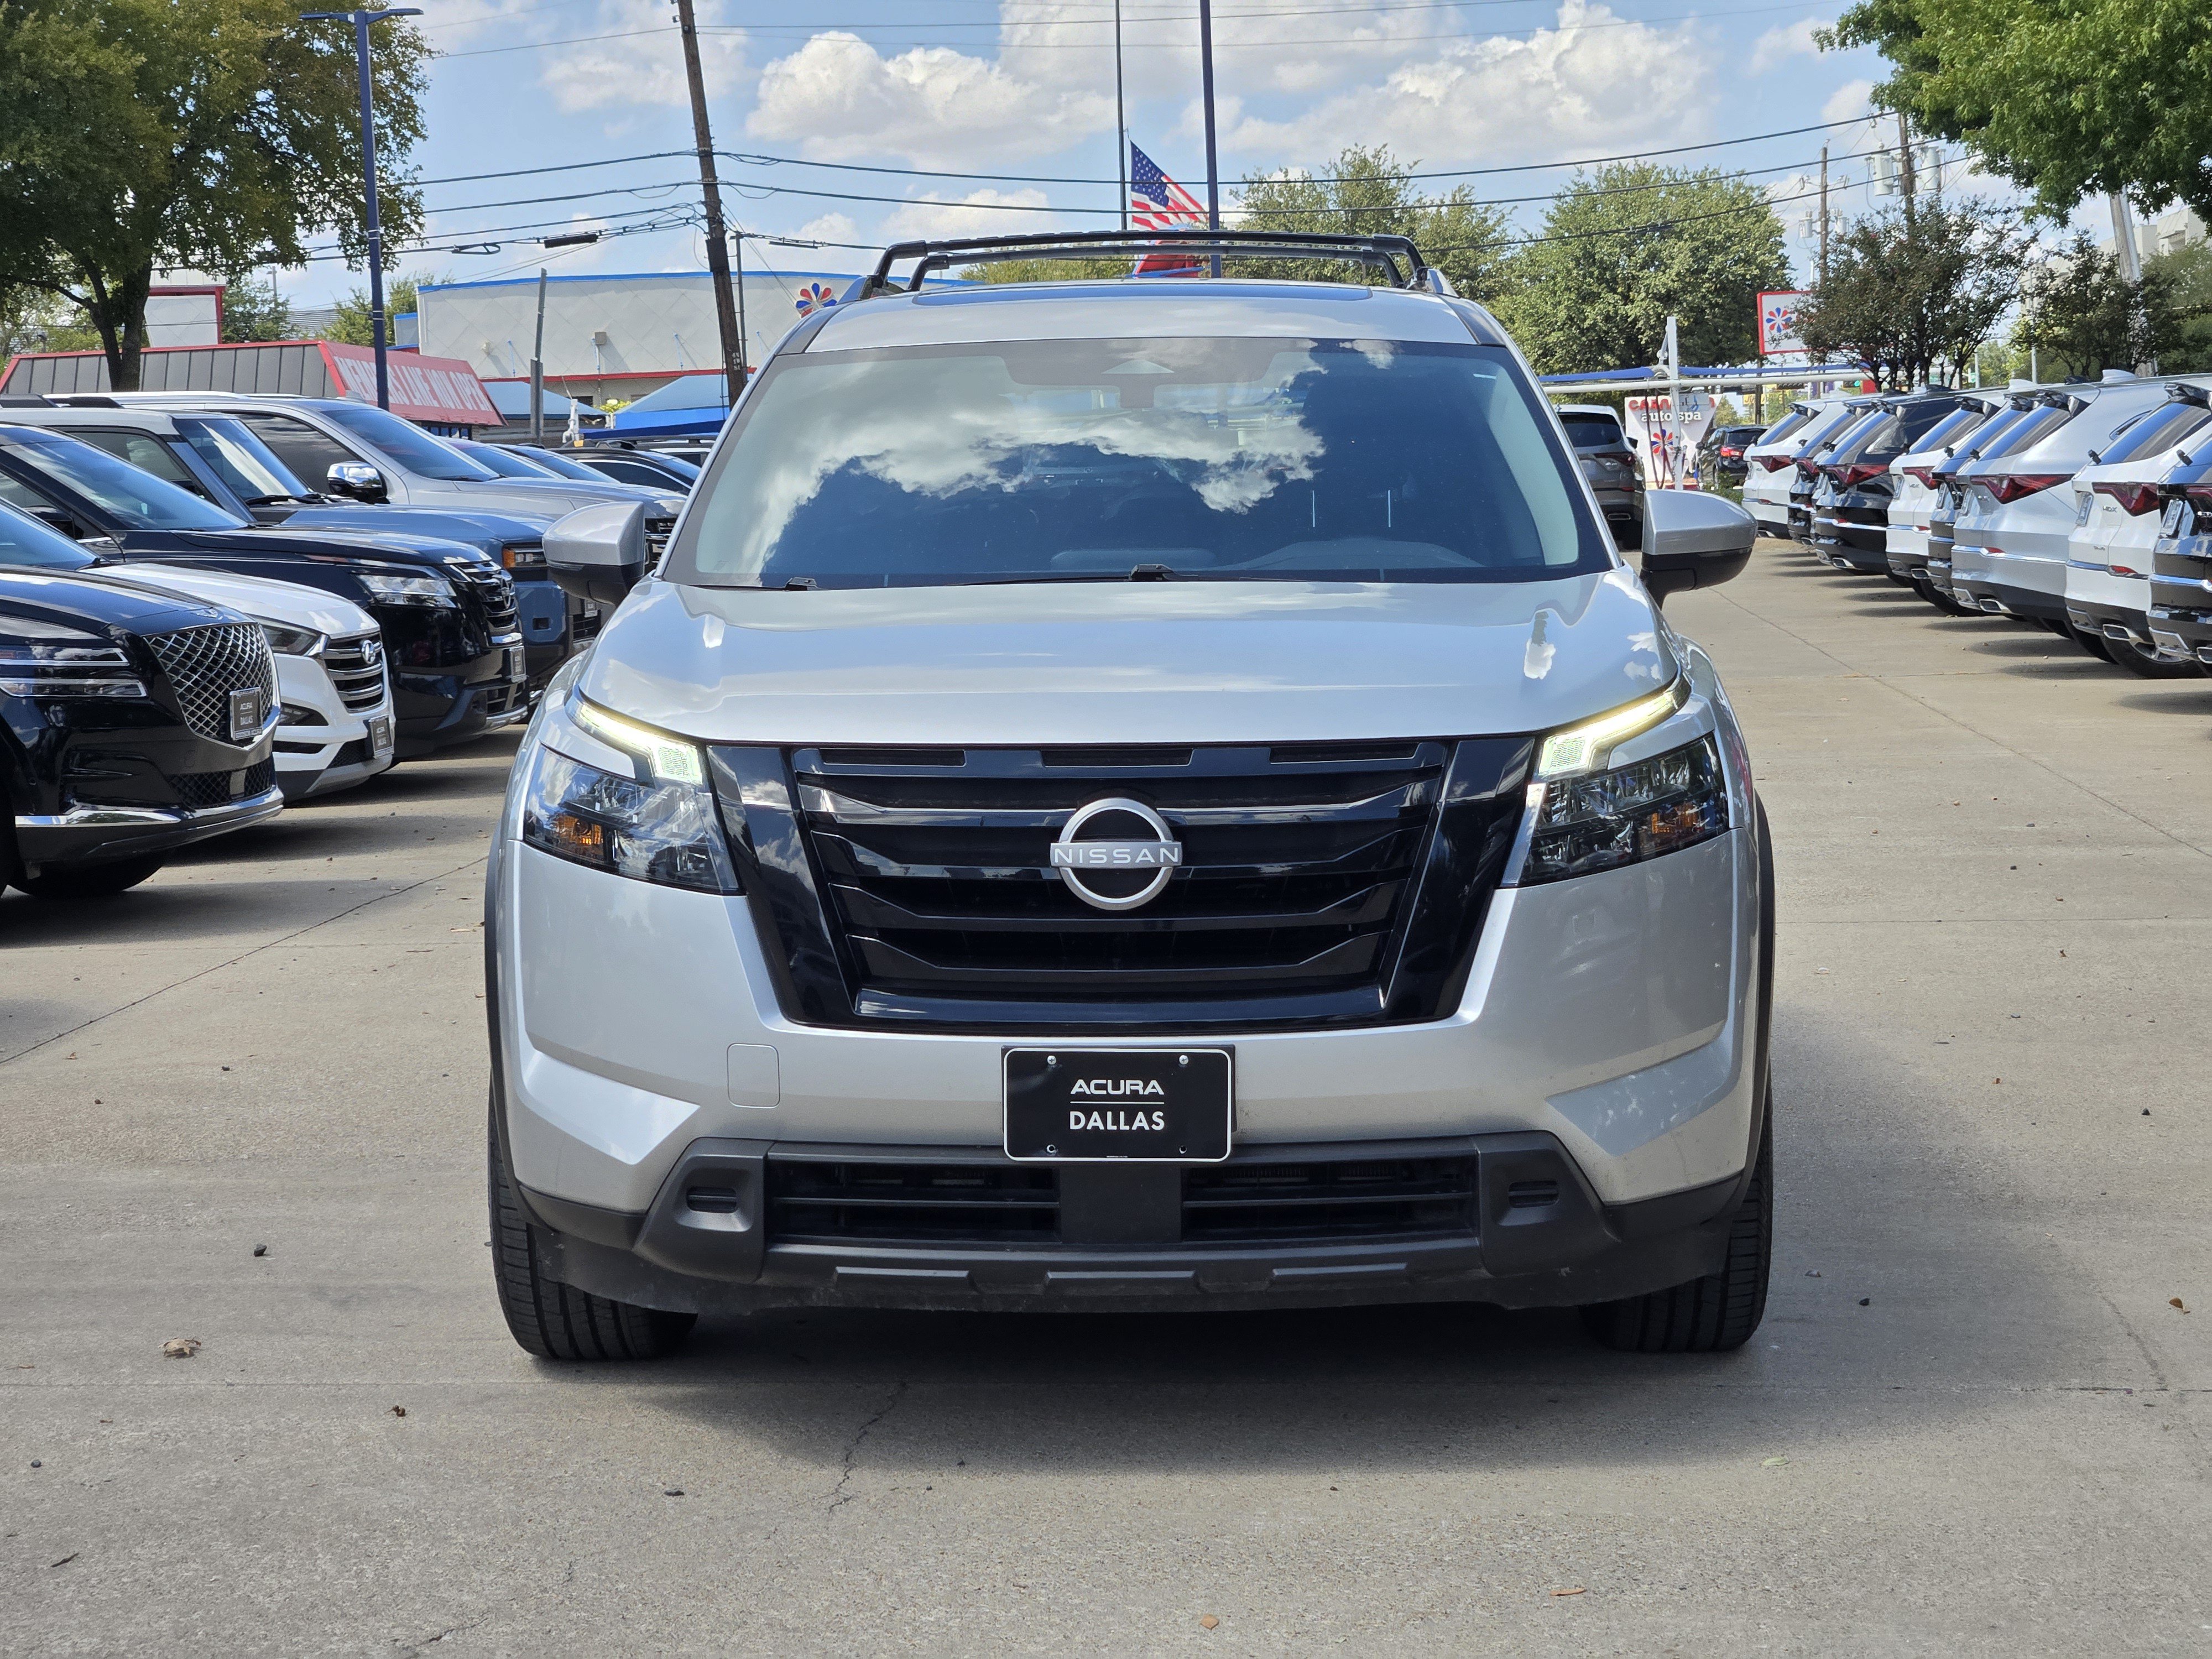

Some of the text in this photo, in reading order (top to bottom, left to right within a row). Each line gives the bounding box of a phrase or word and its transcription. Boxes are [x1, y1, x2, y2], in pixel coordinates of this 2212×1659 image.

[394, 365, 440, 408] LANE
[424, 369, 464, 409] NOW
[450, 371, 494, 412] OPEN
[1641, 411, 1702, 424] auto spa
[1054, 847, 1178, 863] NISSAN
[1070, 1079, 1165, 1095] ACURA
[1070, 1111, 1165, 1130] DALLAS
